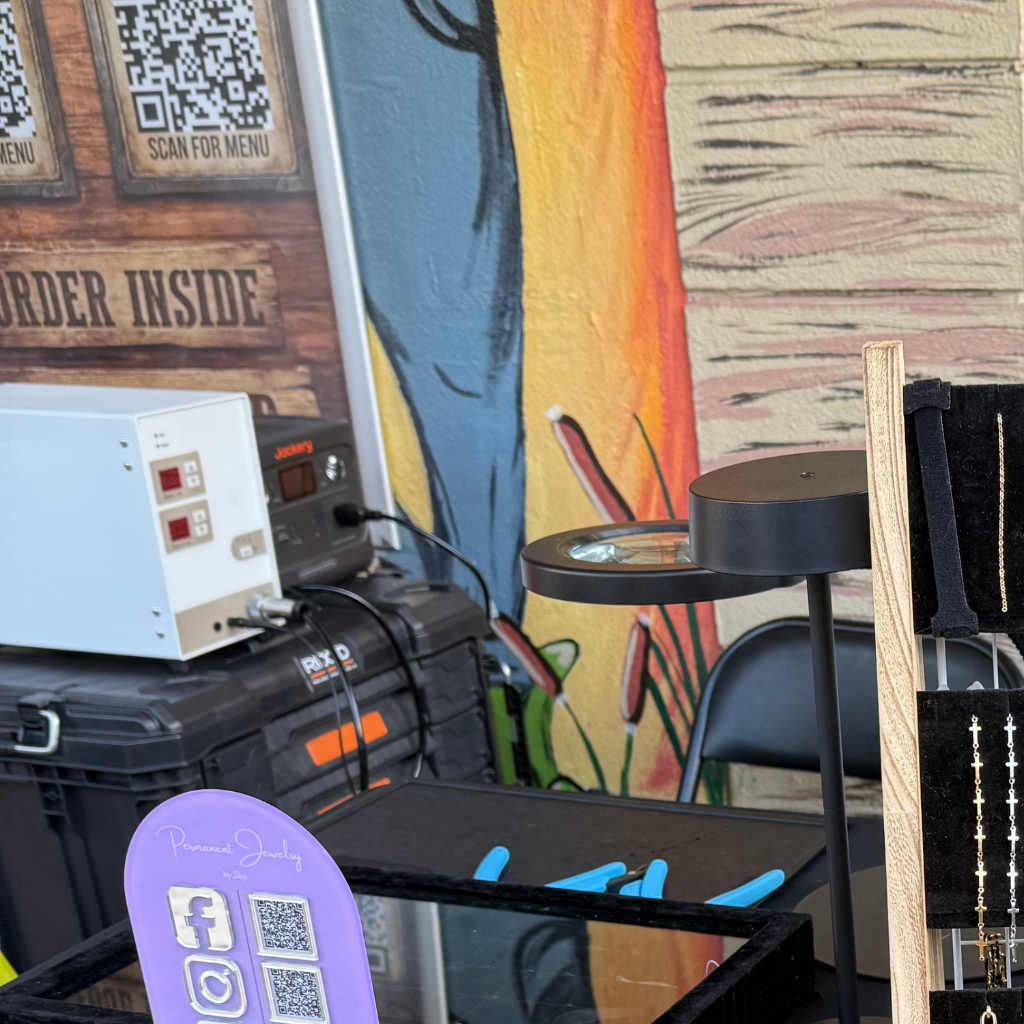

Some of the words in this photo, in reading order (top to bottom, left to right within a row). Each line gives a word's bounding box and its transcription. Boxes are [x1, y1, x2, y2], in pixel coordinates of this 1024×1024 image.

[149, 136, 189, 161] SCAN
[192, 136, 223, 160] FOR
[225, 134, 271, 159] MENU
[124, 269, 266, 329] INSIDE
[274, 440, 313, 460] Jackery
[156, 825, 235, 858] Permanent
[234, 828, 302, 872] Jewelry
[222, 870, 232, 881] by
